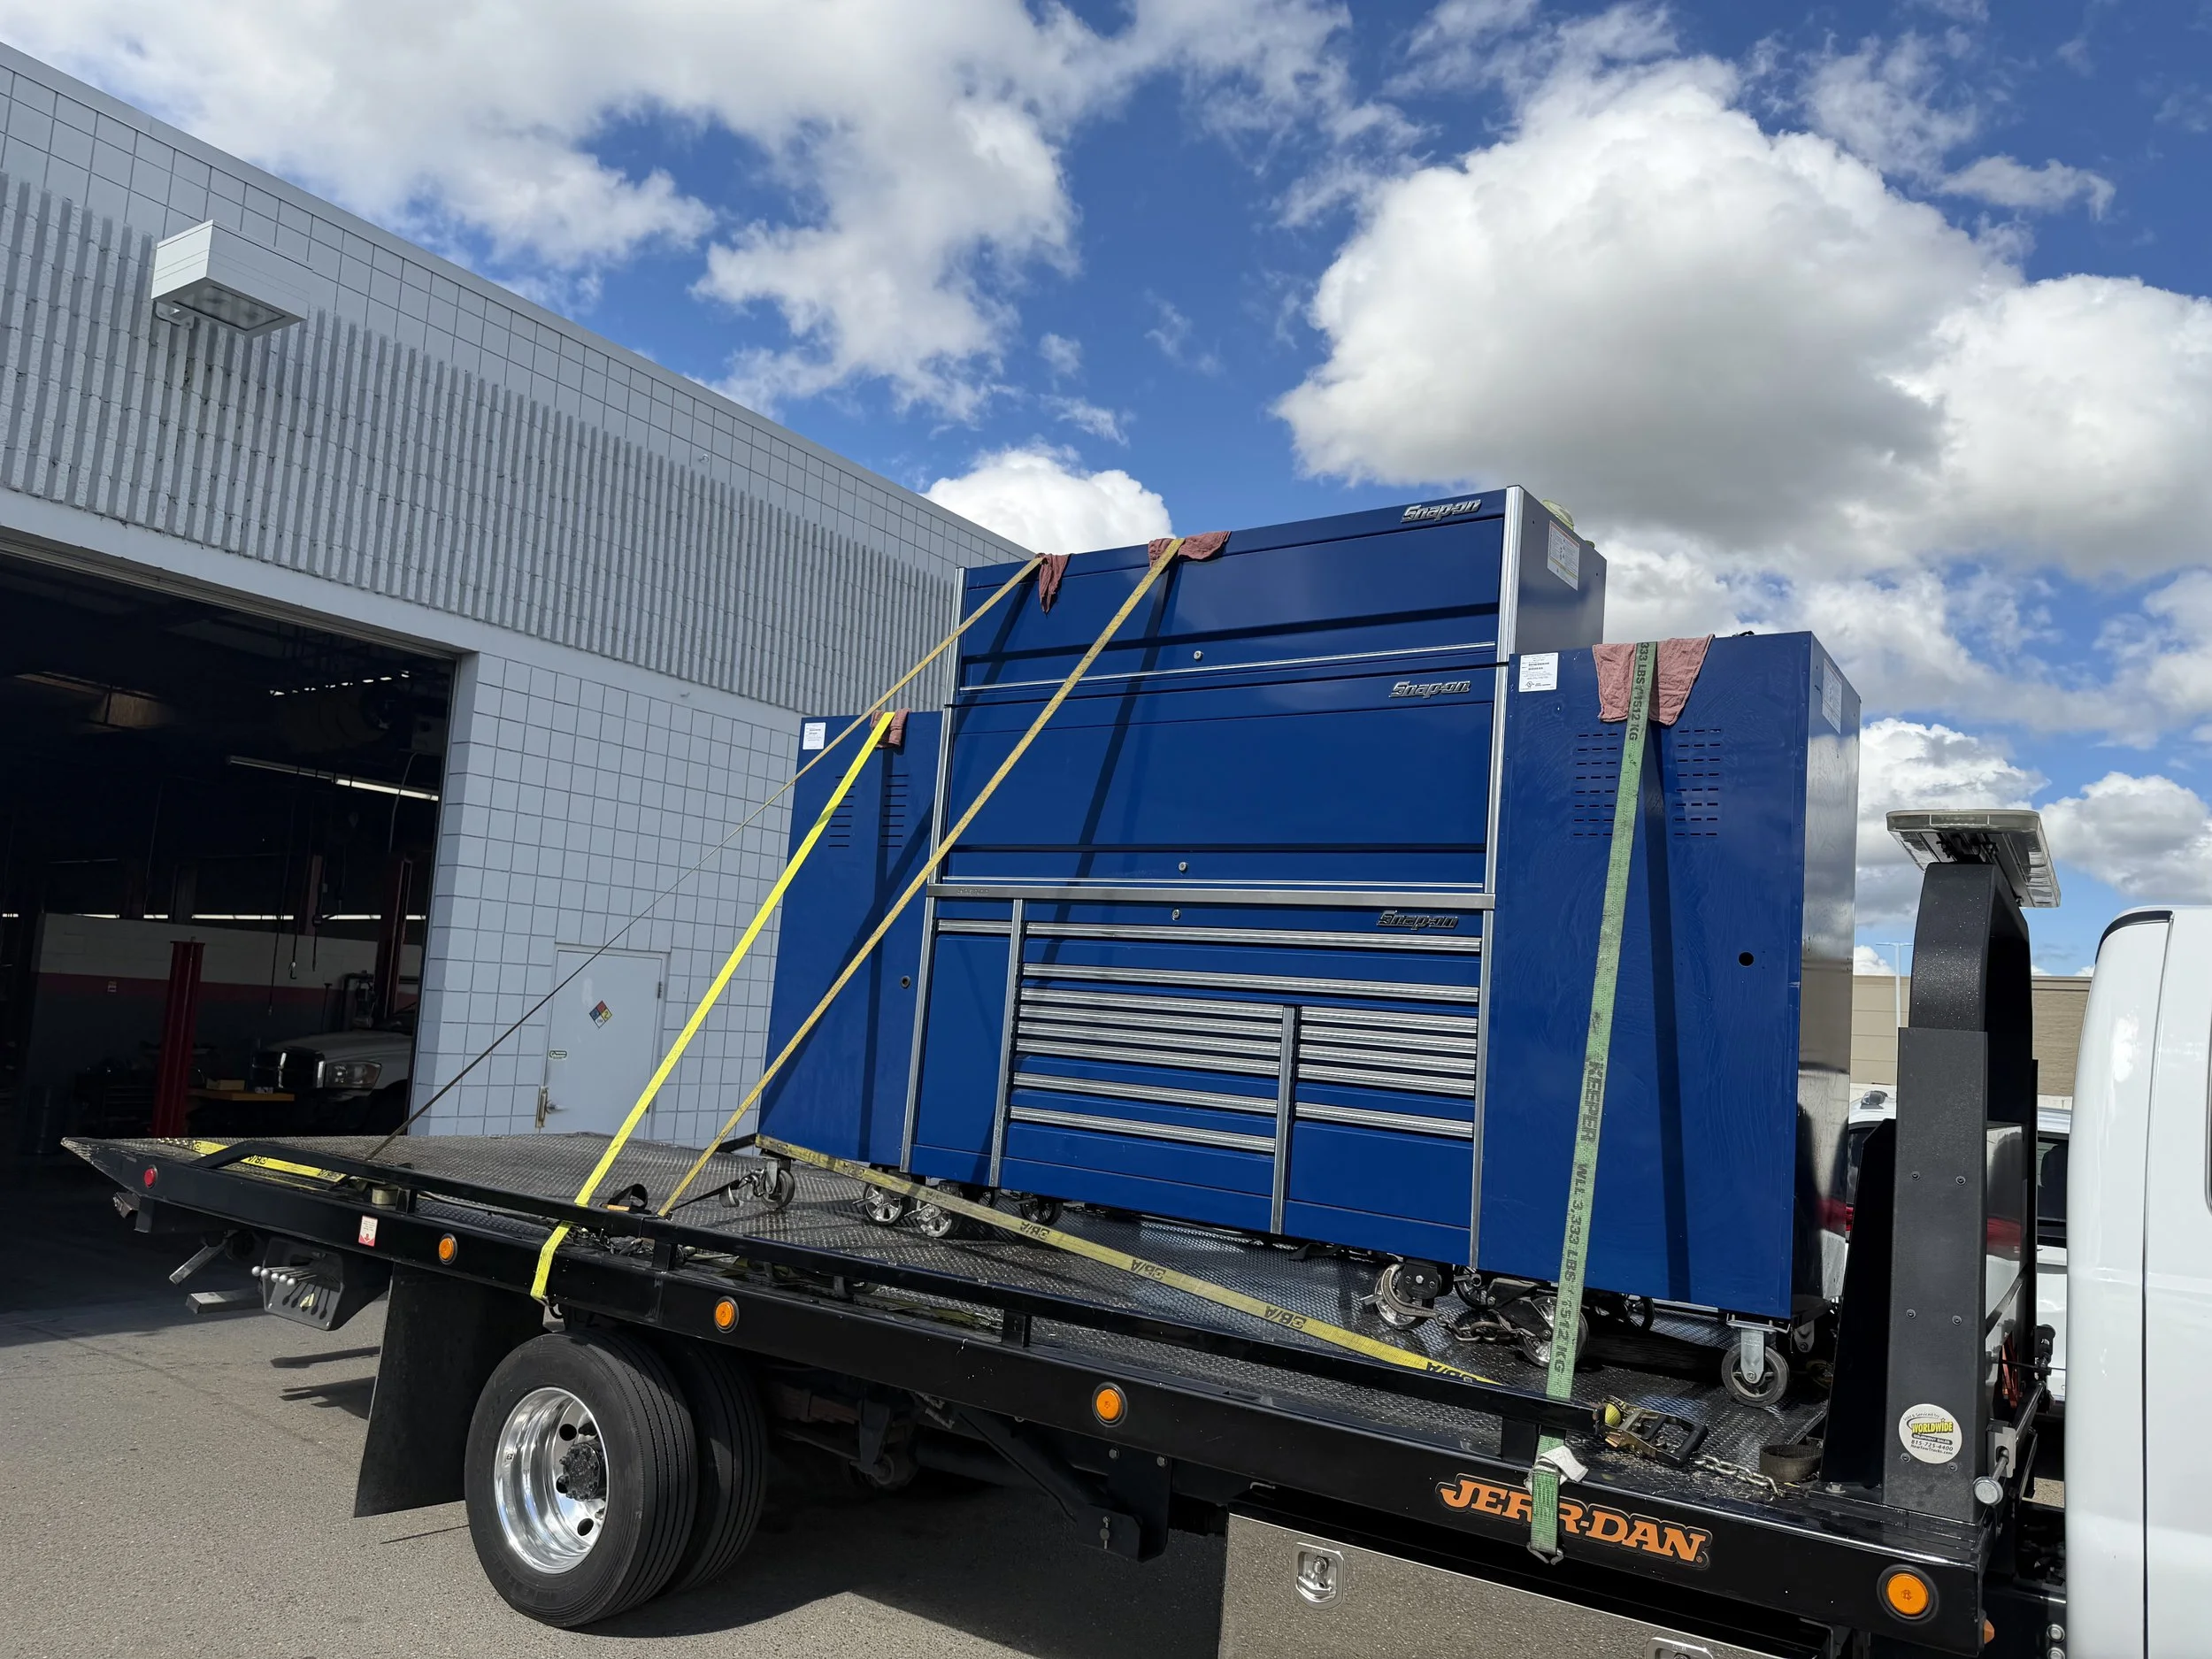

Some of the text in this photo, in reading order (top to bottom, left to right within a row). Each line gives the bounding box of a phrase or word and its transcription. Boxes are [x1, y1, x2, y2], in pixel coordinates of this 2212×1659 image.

[1401, 499, 1481, 522] Snap-on
[1635, 664, 1647, 685] LBS
[1388, 680, 1471, 699] Snap-on
[1629, 725, 1640, 741] KG
[1377, 910, 1459, 931] Snap-on
[1580, 1062, 1604, 1143] KEEPER
[1574, 1164, 1588, 1195] WLL
[1569, 1199, 1584, 1246] 3,333
[1564, 1247, 1578, 1283] LBS
[1554, 1344, 1568, 1374] KG
[1911, 1421, 1953, 1433] WORLDWIDE
[1911, 1440, 1953, 1451] 815-725-4400
